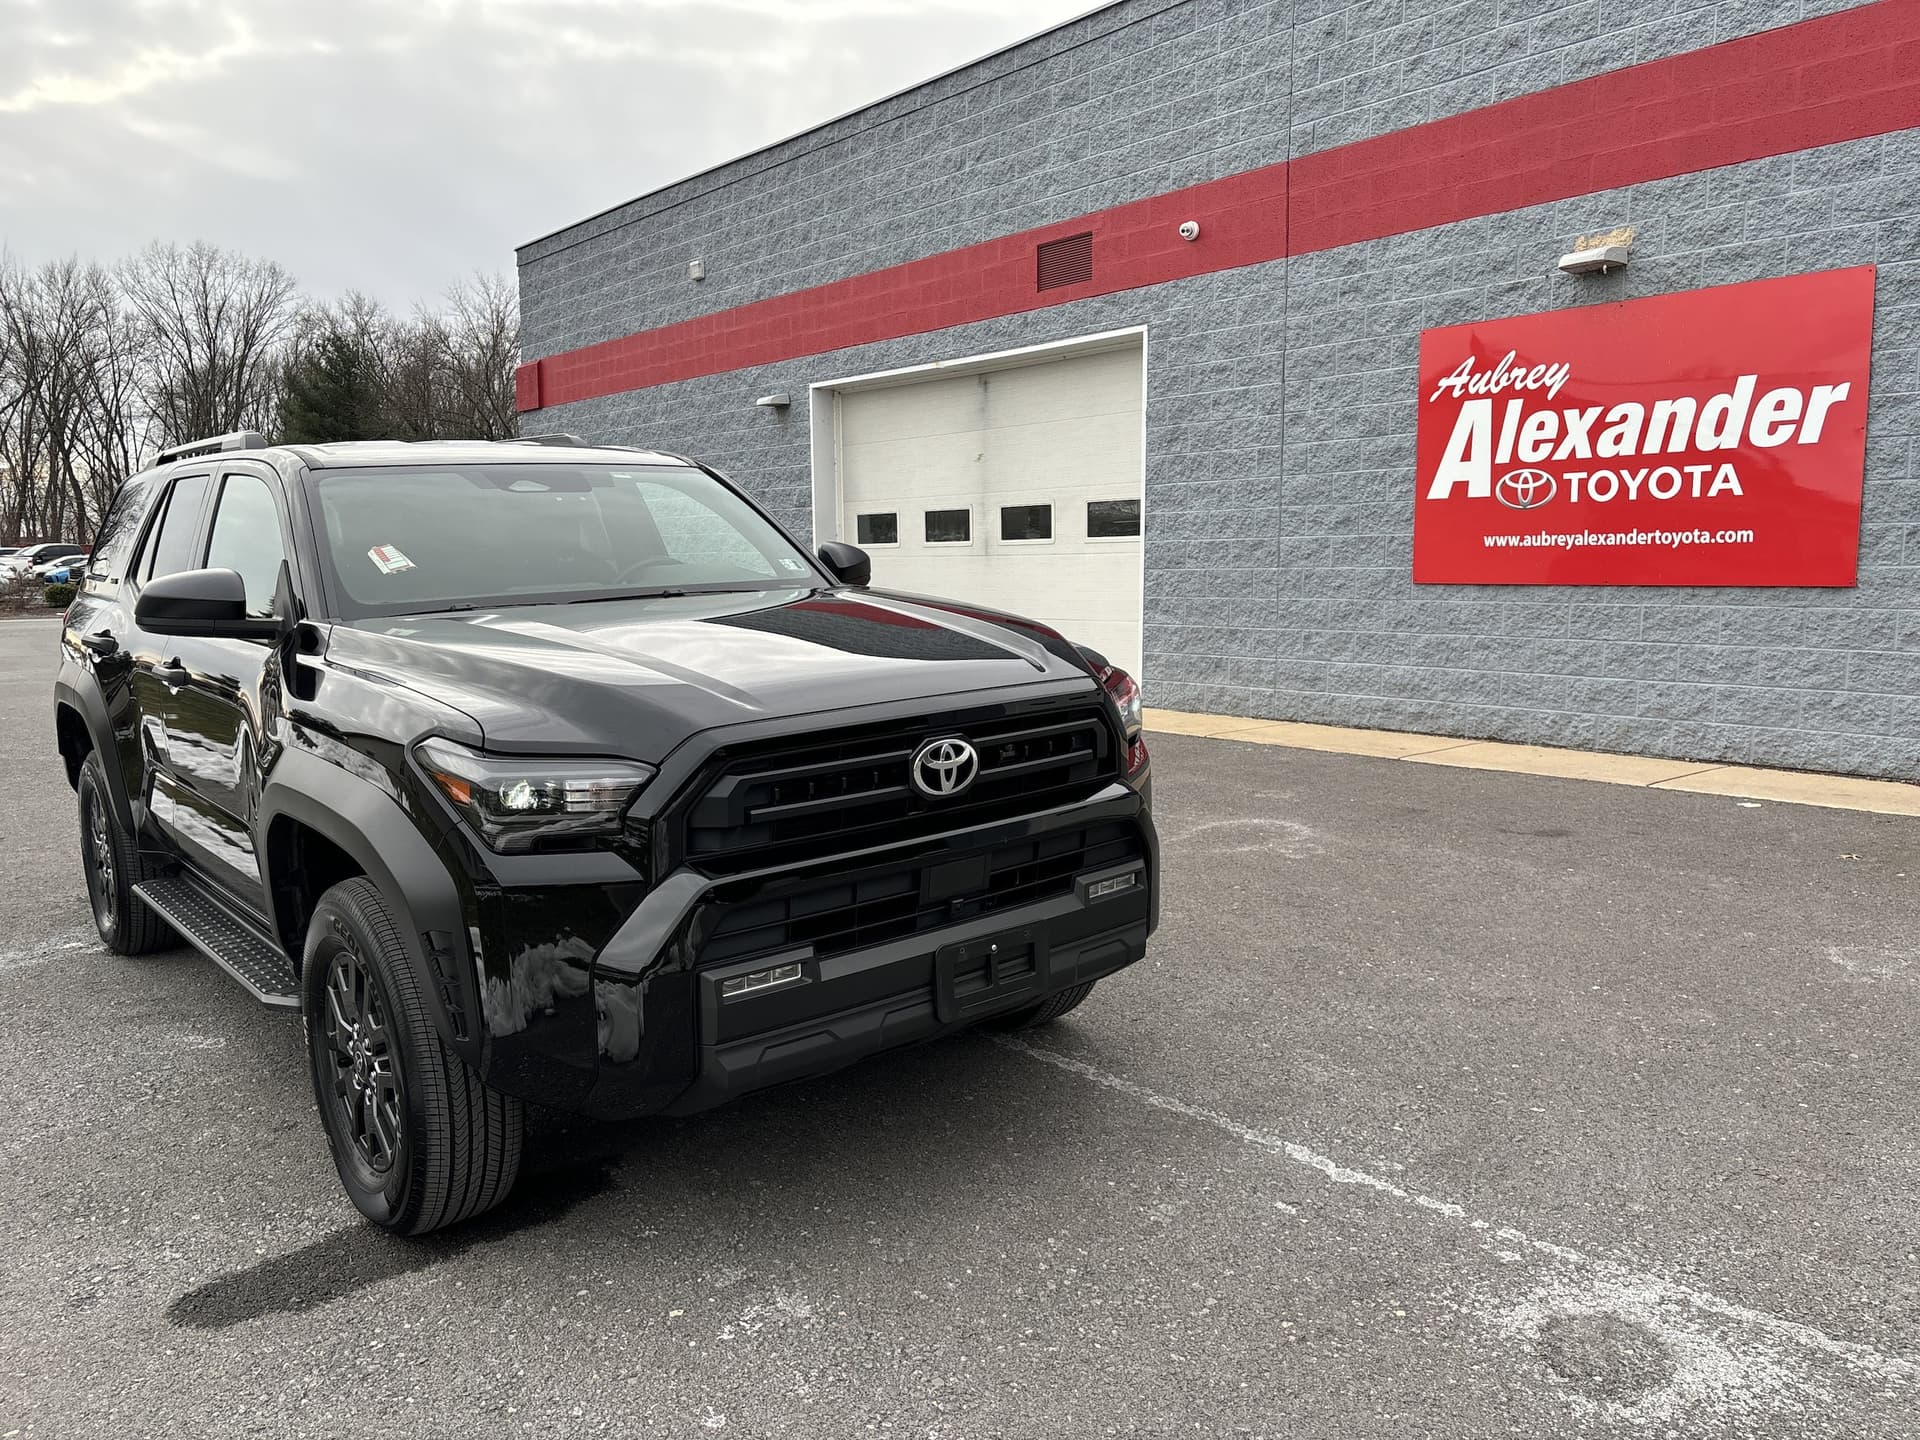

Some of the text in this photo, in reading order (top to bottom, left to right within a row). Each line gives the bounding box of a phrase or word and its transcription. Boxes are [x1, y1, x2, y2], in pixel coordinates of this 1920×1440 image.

[1430, 350, 1570, 402] Aubrey
[1426, 374, 1852, 500] Alexander
[1563, 463, 1744, 503] TOYOTA
[1483, 529, 1754, 550] www.aubreyalexandertoyota.com
